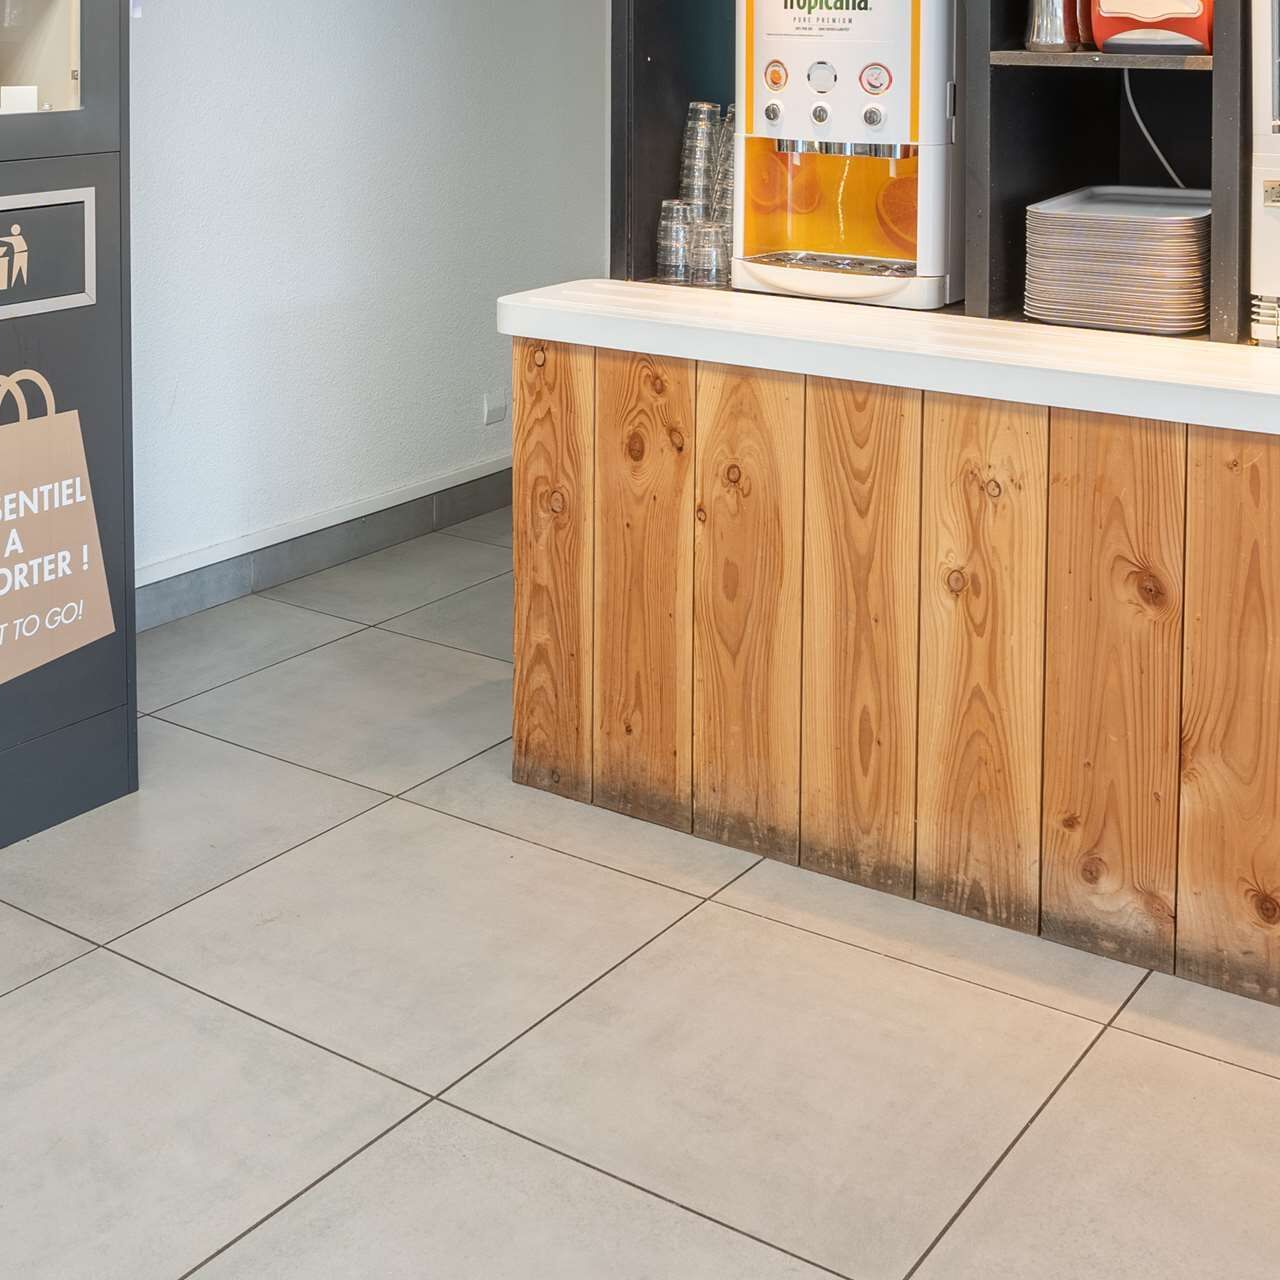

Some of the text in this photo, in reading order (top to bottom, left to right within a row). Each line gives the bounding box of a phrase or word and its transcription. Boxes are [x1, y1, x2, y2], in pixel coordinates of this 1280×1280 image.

[793, 16, 853, 24] PURE PREMIUM
[4, 528, 24, 558] A
[81, 543, 90, 571] !
[14, 614, 40, 641] TO
[45, 599, 84, 629] GO!
